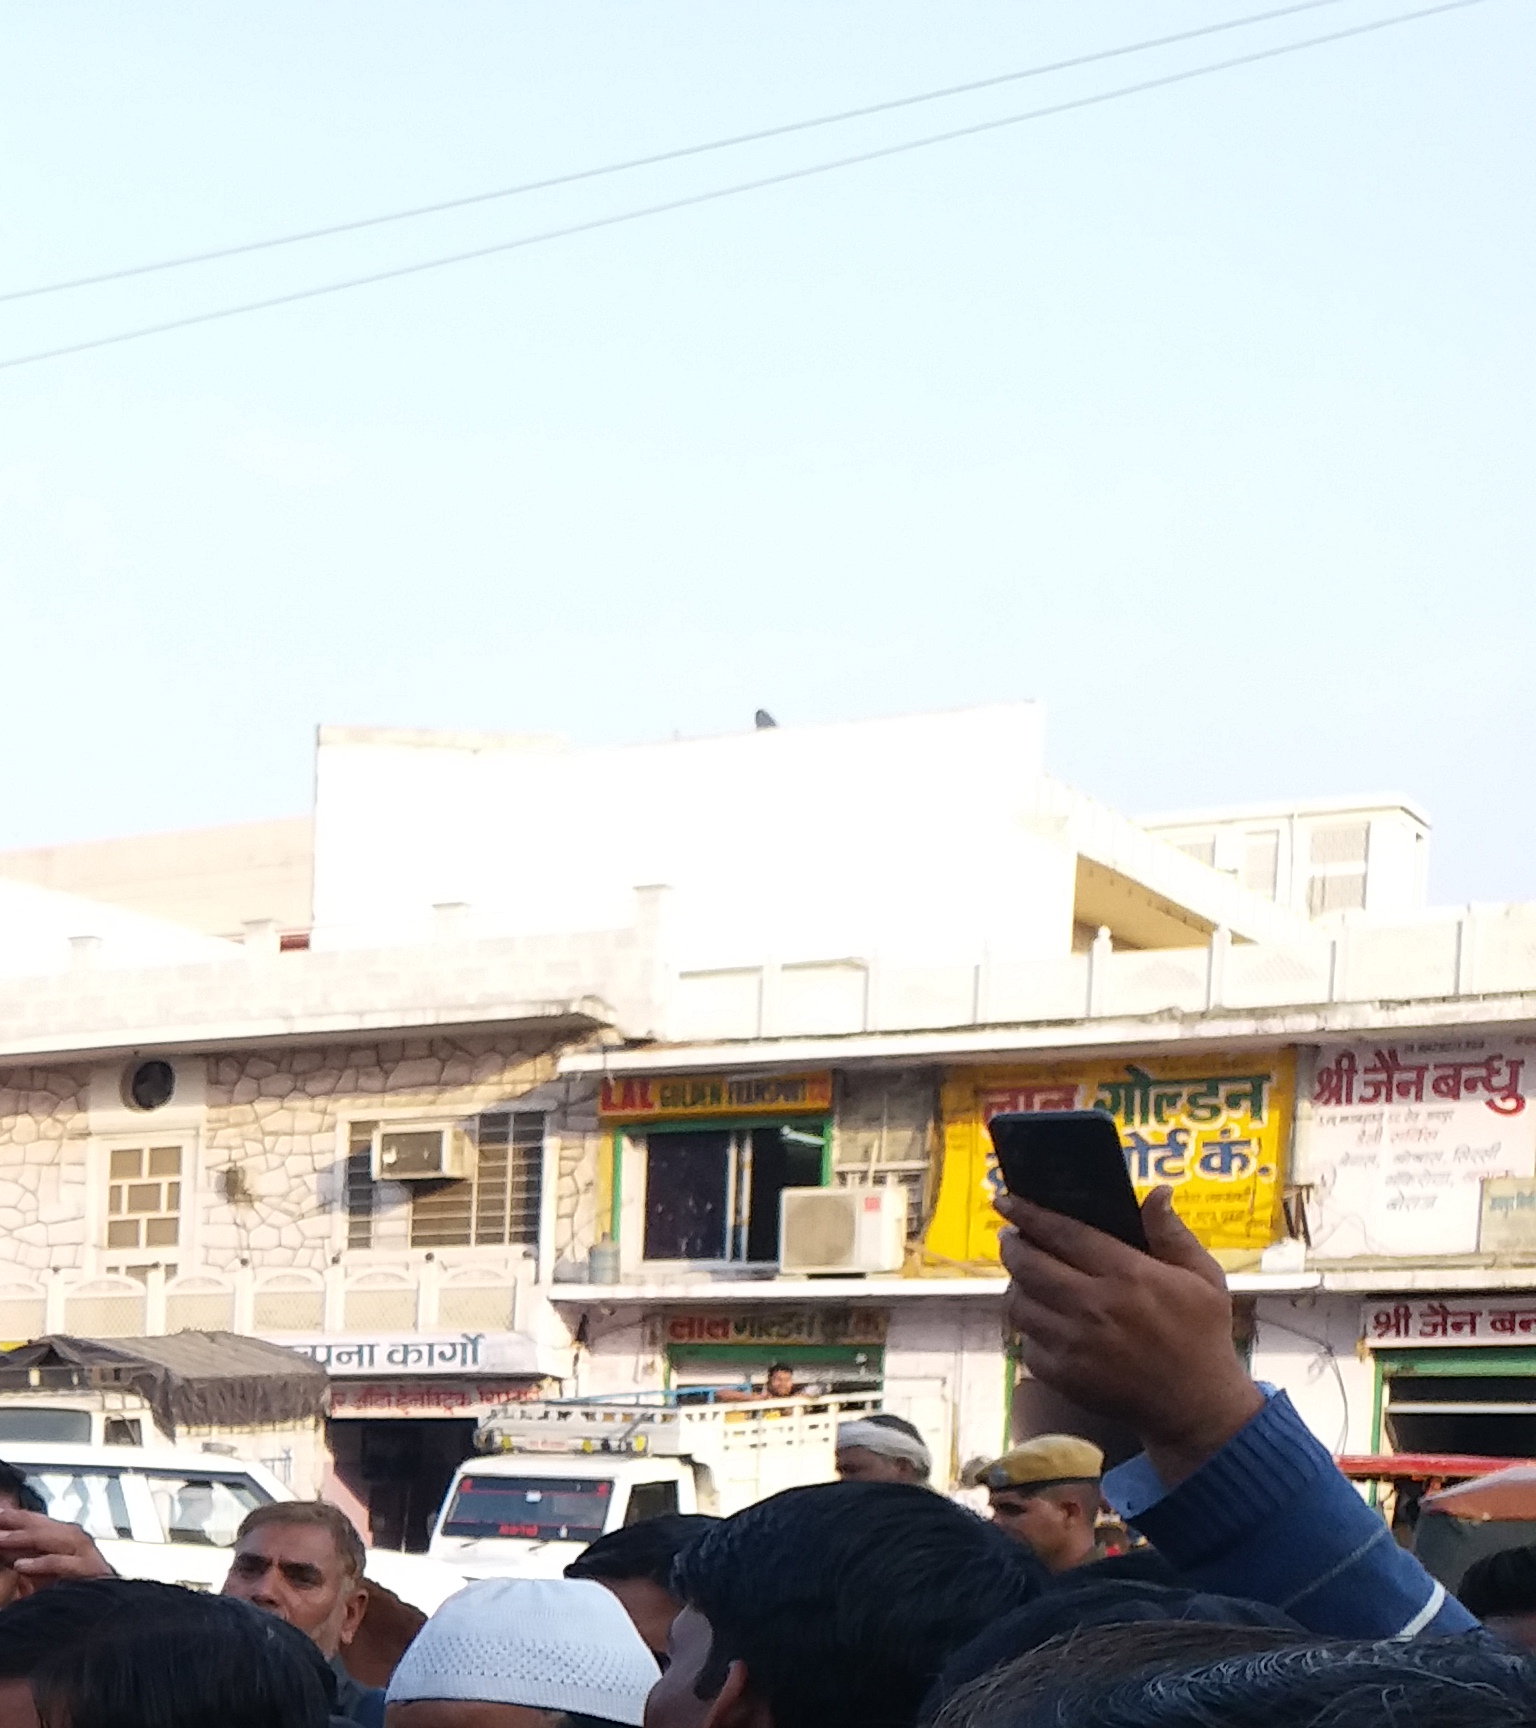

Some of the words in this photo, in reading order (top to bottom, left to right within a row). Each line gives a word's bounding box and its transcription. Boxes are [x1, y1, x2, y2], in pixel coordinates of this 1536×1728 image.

[1094, 1064, 1273, 1127] गोल्डन
[1312, 1051, 1358, 1106] श्री
[1358, 1049, 1429, 1105] जैन
[1432, 1053, 1527, 1117] बन्धु
[1373, 1304, 1413, 1338] श्री
[1419, 1302, 1482, 1337] जैन
[386, 1333, 485, 1368] कार्गो
